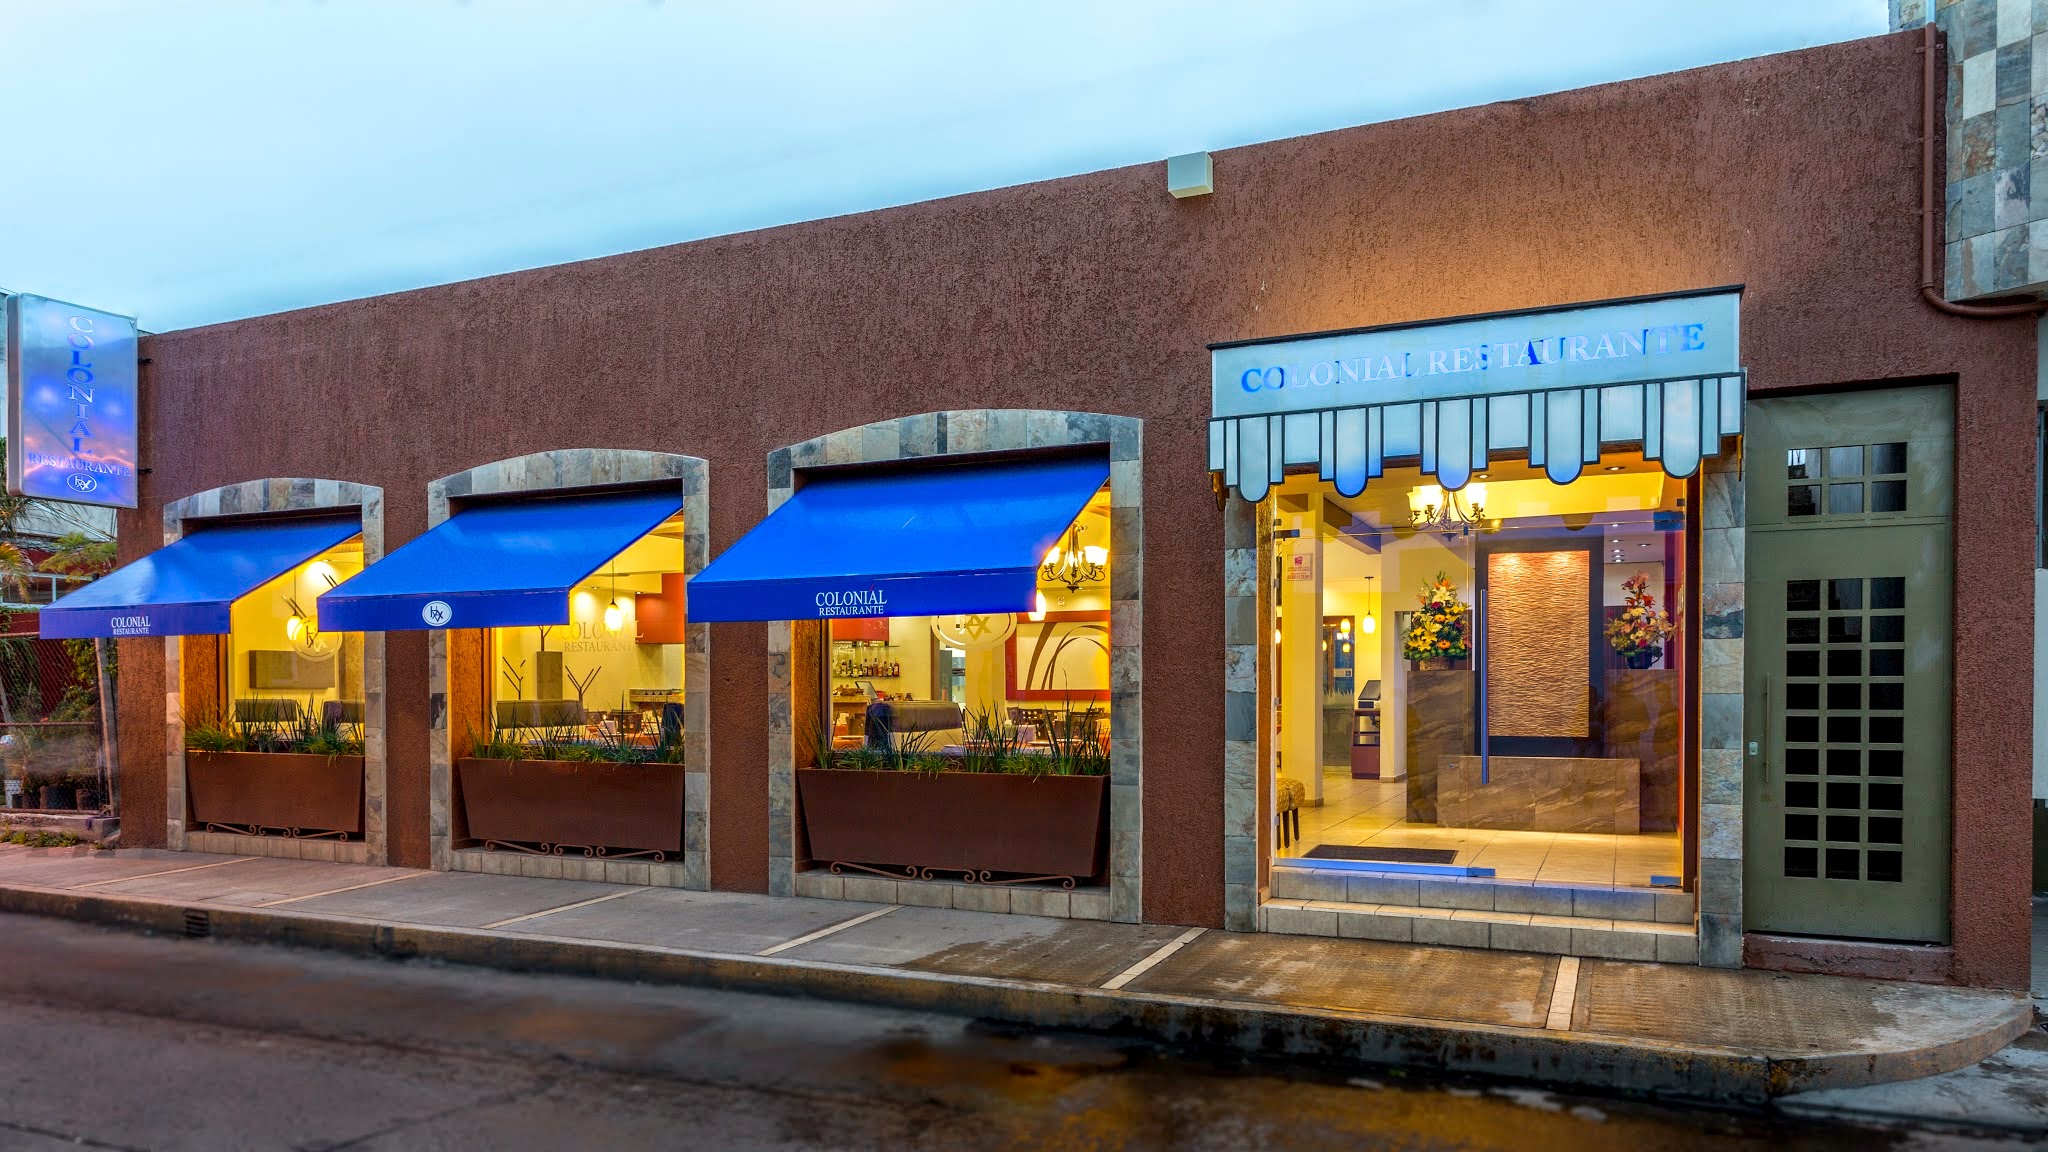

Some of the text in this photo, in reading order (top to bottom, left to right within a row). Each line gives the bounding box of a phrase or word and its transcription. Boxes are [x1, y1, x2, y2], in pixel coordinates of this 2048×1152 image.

[1241, 322, 1706, 393] COLONIAL RESTAURANTE
[67, 315, 96, 454] COLONIAL
[28, 452, 131, 477] RESTAURANTE
[814, 589, 888, 606] COLONIAL
[819, 605, 885, 616] RESTAURANTE
[111, 615, 151, 628] COLONIAL
[113, 627, 150, 635] RESTAURANTE
